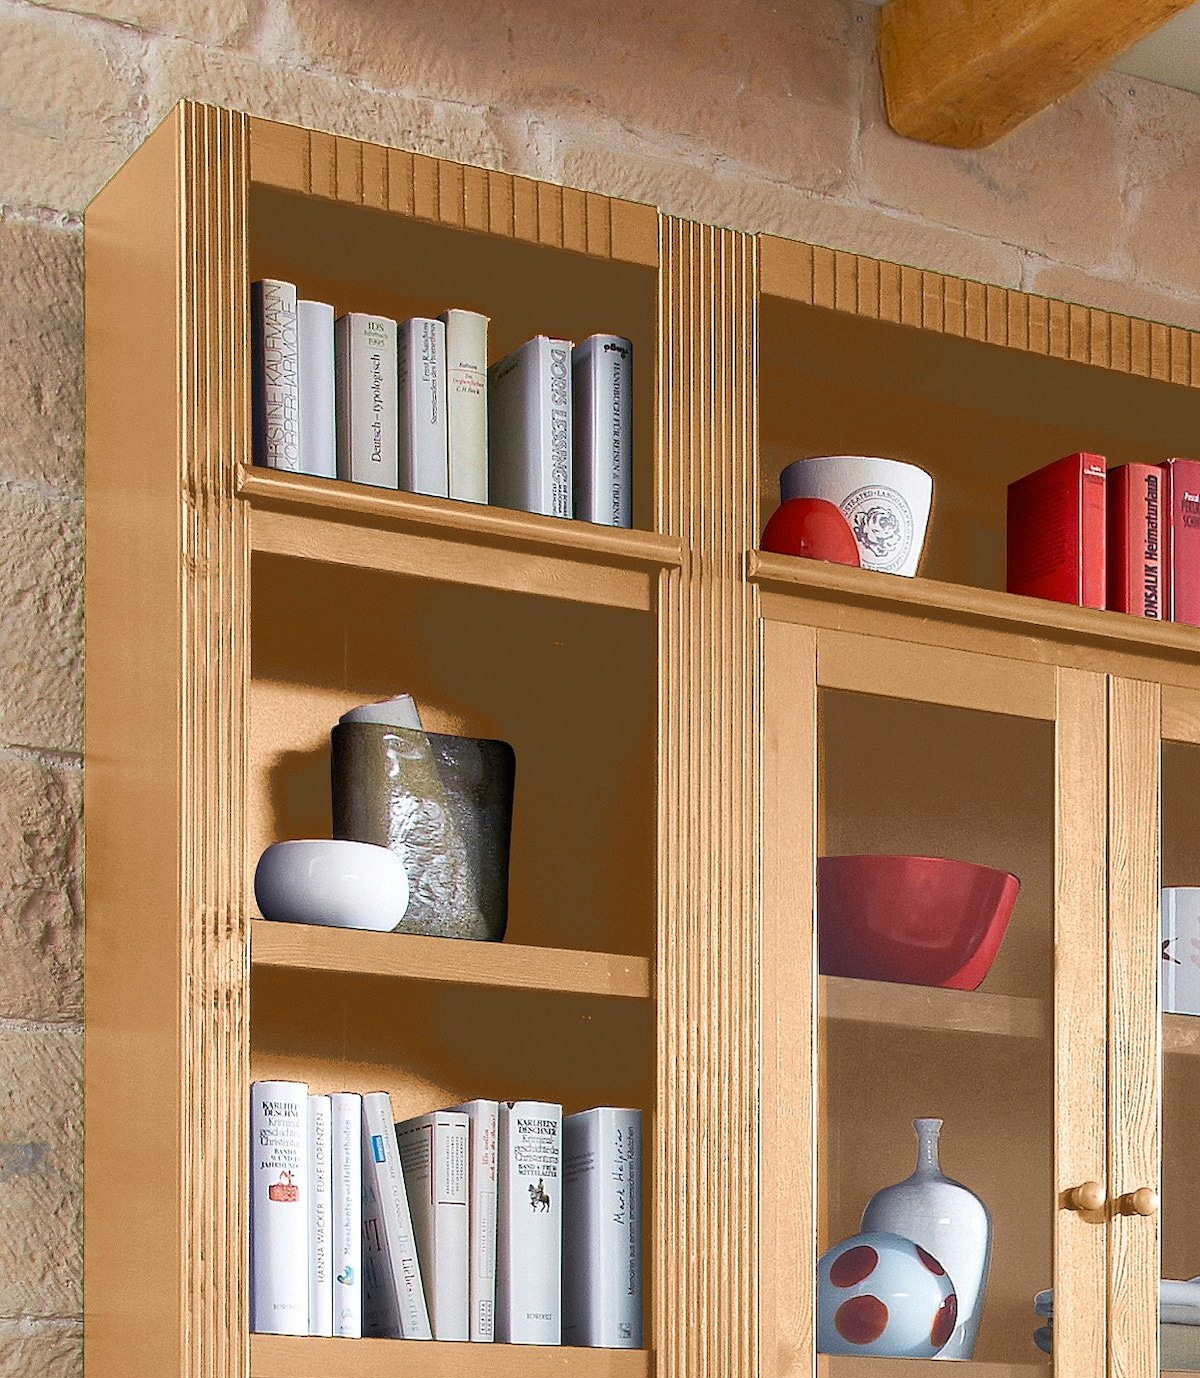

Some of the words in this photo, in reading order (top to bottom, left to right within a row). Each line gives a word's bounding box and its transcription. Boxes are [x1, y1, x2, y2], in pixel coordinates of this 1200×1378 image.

[265, 284, 282, 387] KAUFMANN
[370, 354, 384, 412] typologisch
[551, 349, 567, 405] DORIS
[371, 422, 382, 462] Deutsch
[552, 409, 567, 484] LESSING
[1145, 475, 1158, 561] Heimaturlaub
[315, 1112, 325, 1165] LORENZEN
[317, 1203, 326, 1245] WACKER
[317, 1247, 326, 1283] HANNA
